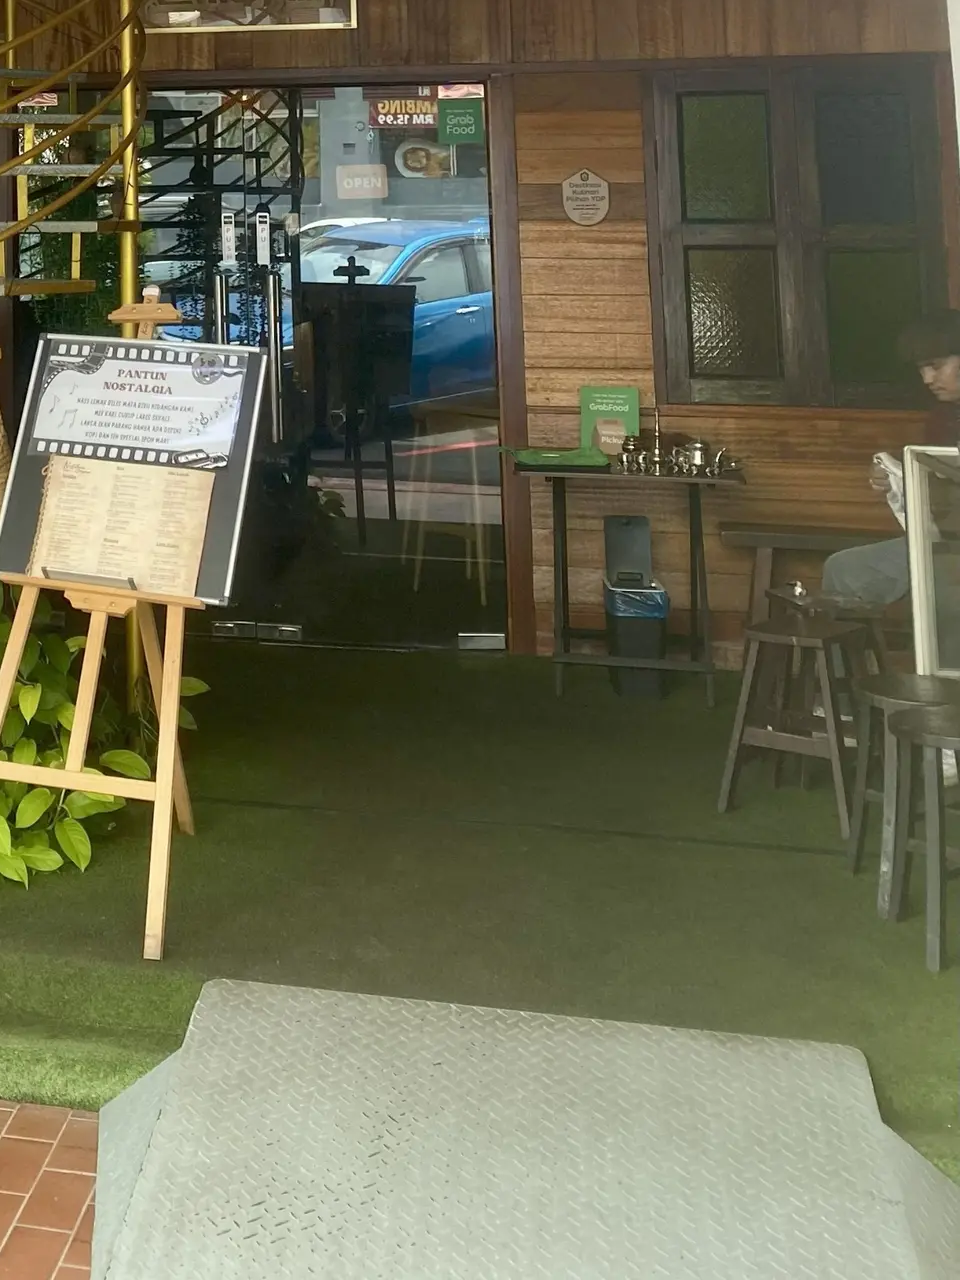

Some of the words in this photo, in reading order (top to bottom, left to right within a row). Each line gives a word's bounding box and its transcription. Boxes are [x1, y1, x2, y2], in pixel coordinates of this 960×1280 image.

[446, 115, 474, 125] Grab
[446, 125, 476, 134] Food
[343, 177, 382, 189] OPEN
[225, 227, 233, 260] PUSH
[117, 369, 167, 380] PANTUN
[103, 381, 173, 395] NOSTALGIA
[589, 403, 629, 412] GrabFood
